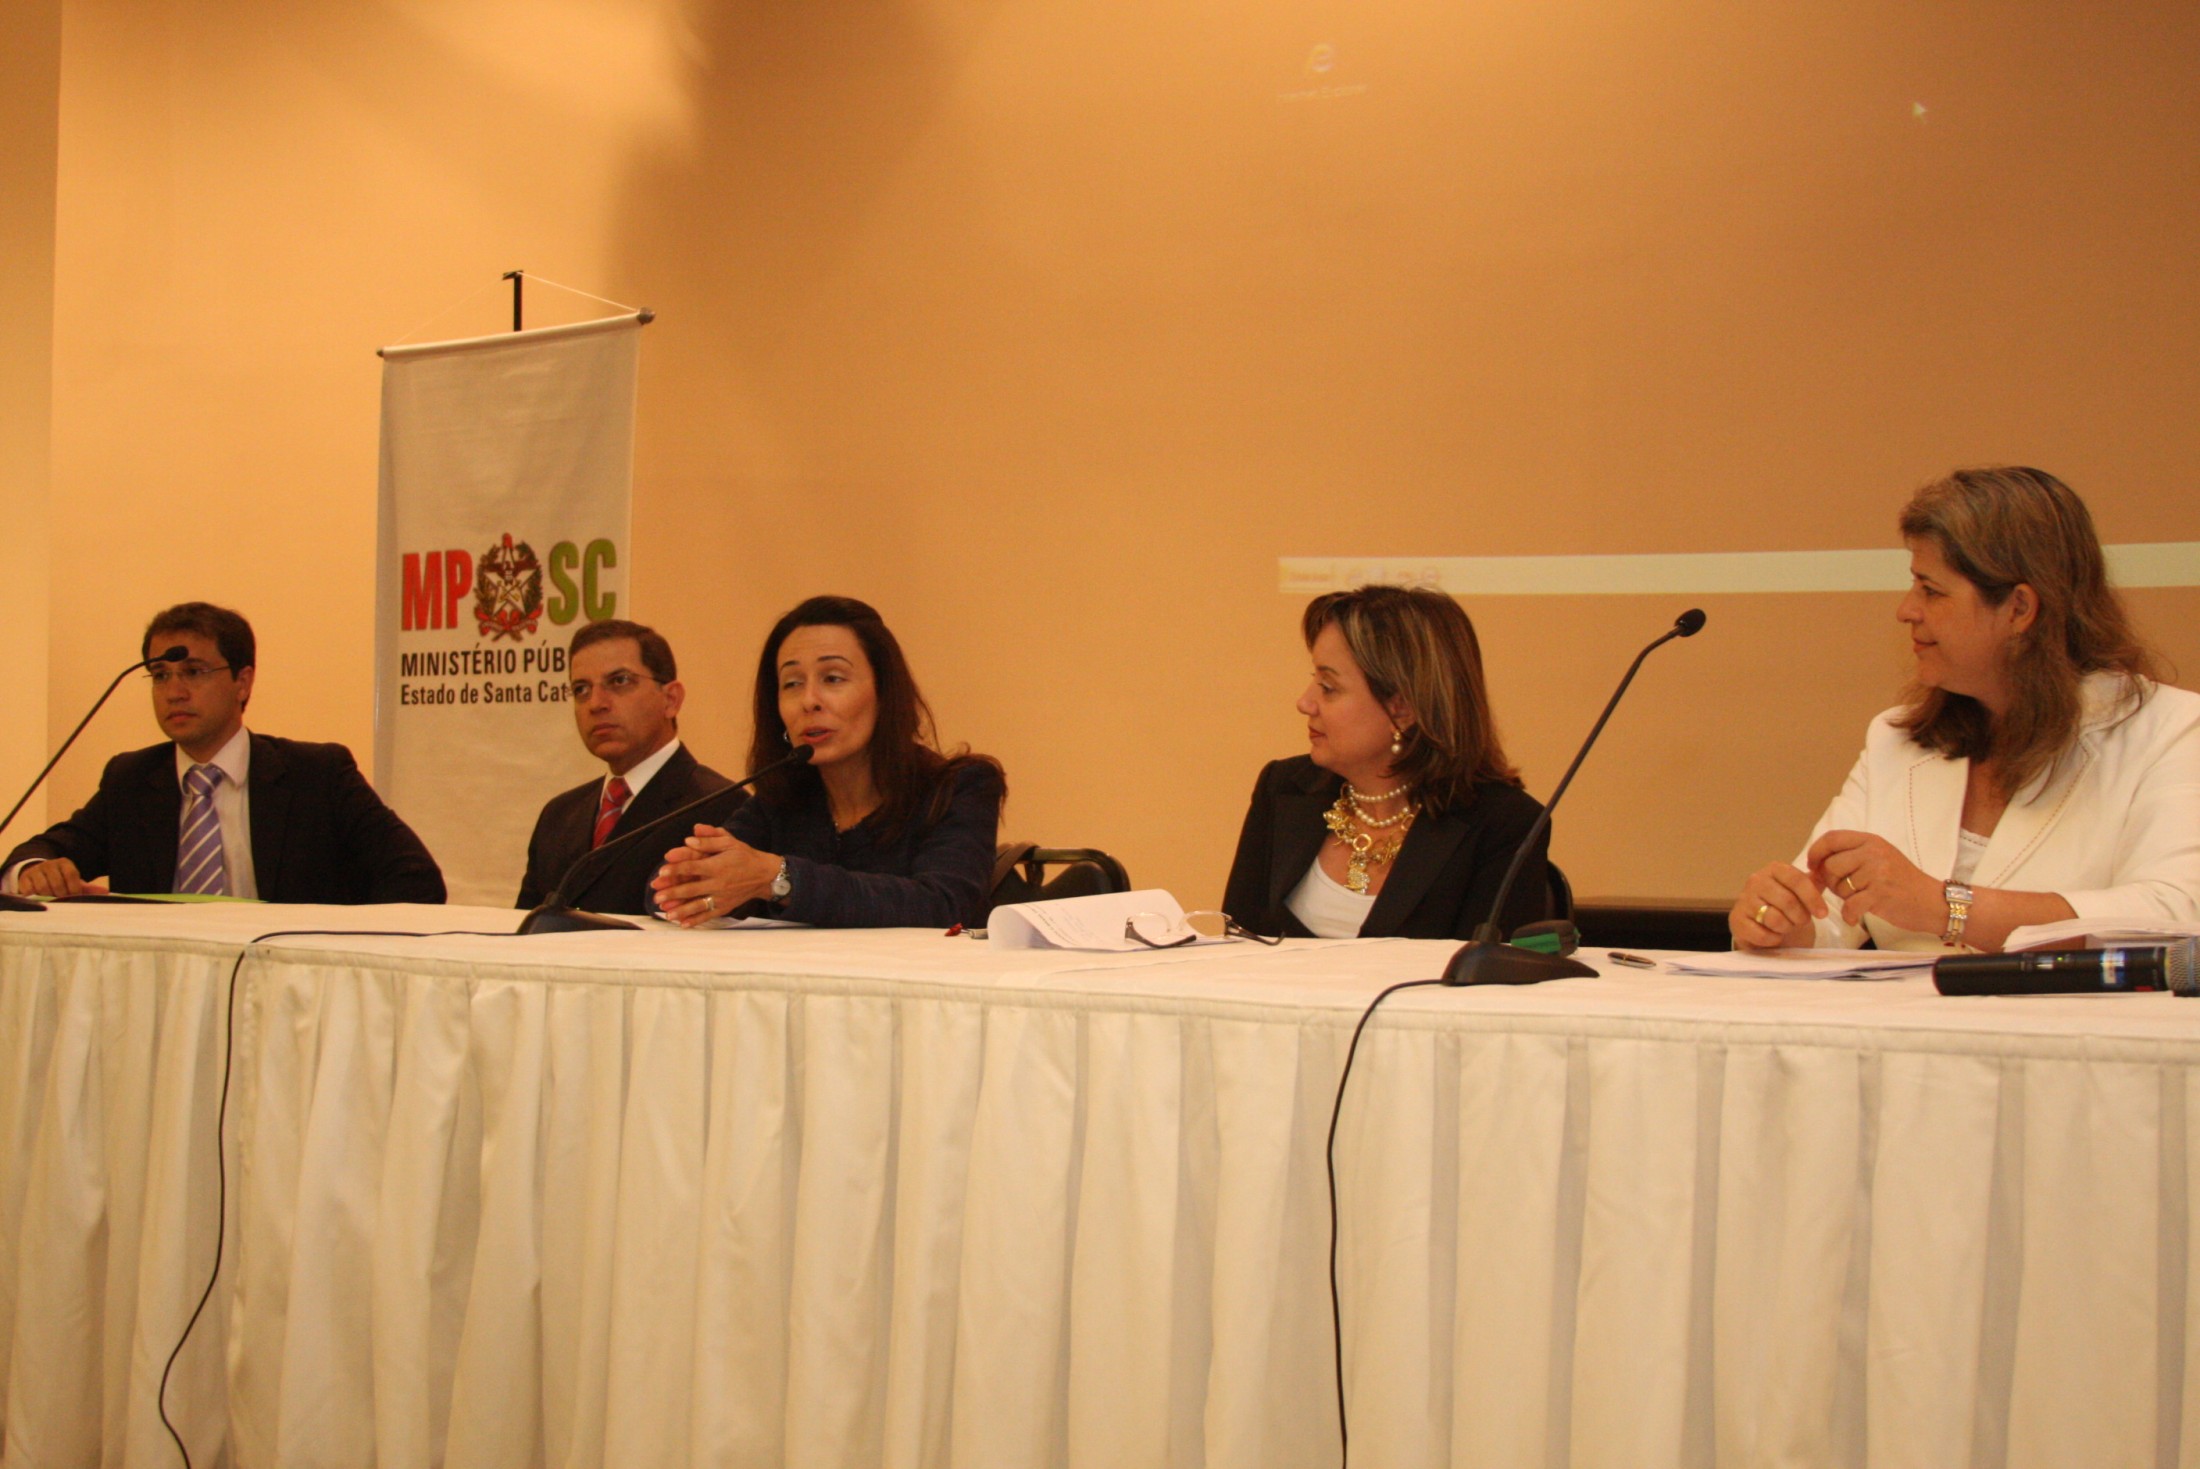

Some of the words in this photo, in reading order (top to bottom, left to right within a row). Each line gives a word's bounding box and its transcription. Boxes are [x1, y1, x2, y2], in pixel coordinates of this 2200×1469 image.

[401, 549, 473, 631] MP
[547, 538, 617, 626] SC
[401, 642, 516, 677] MINISTÉRIO
[524, 640, 566, 673] PÚB
[401, 683, 455, 705] Estado
[460, 682, 478, 703] de
[484, 680, 532, 703] Santa
[538, 680, 568, 702] Cat
